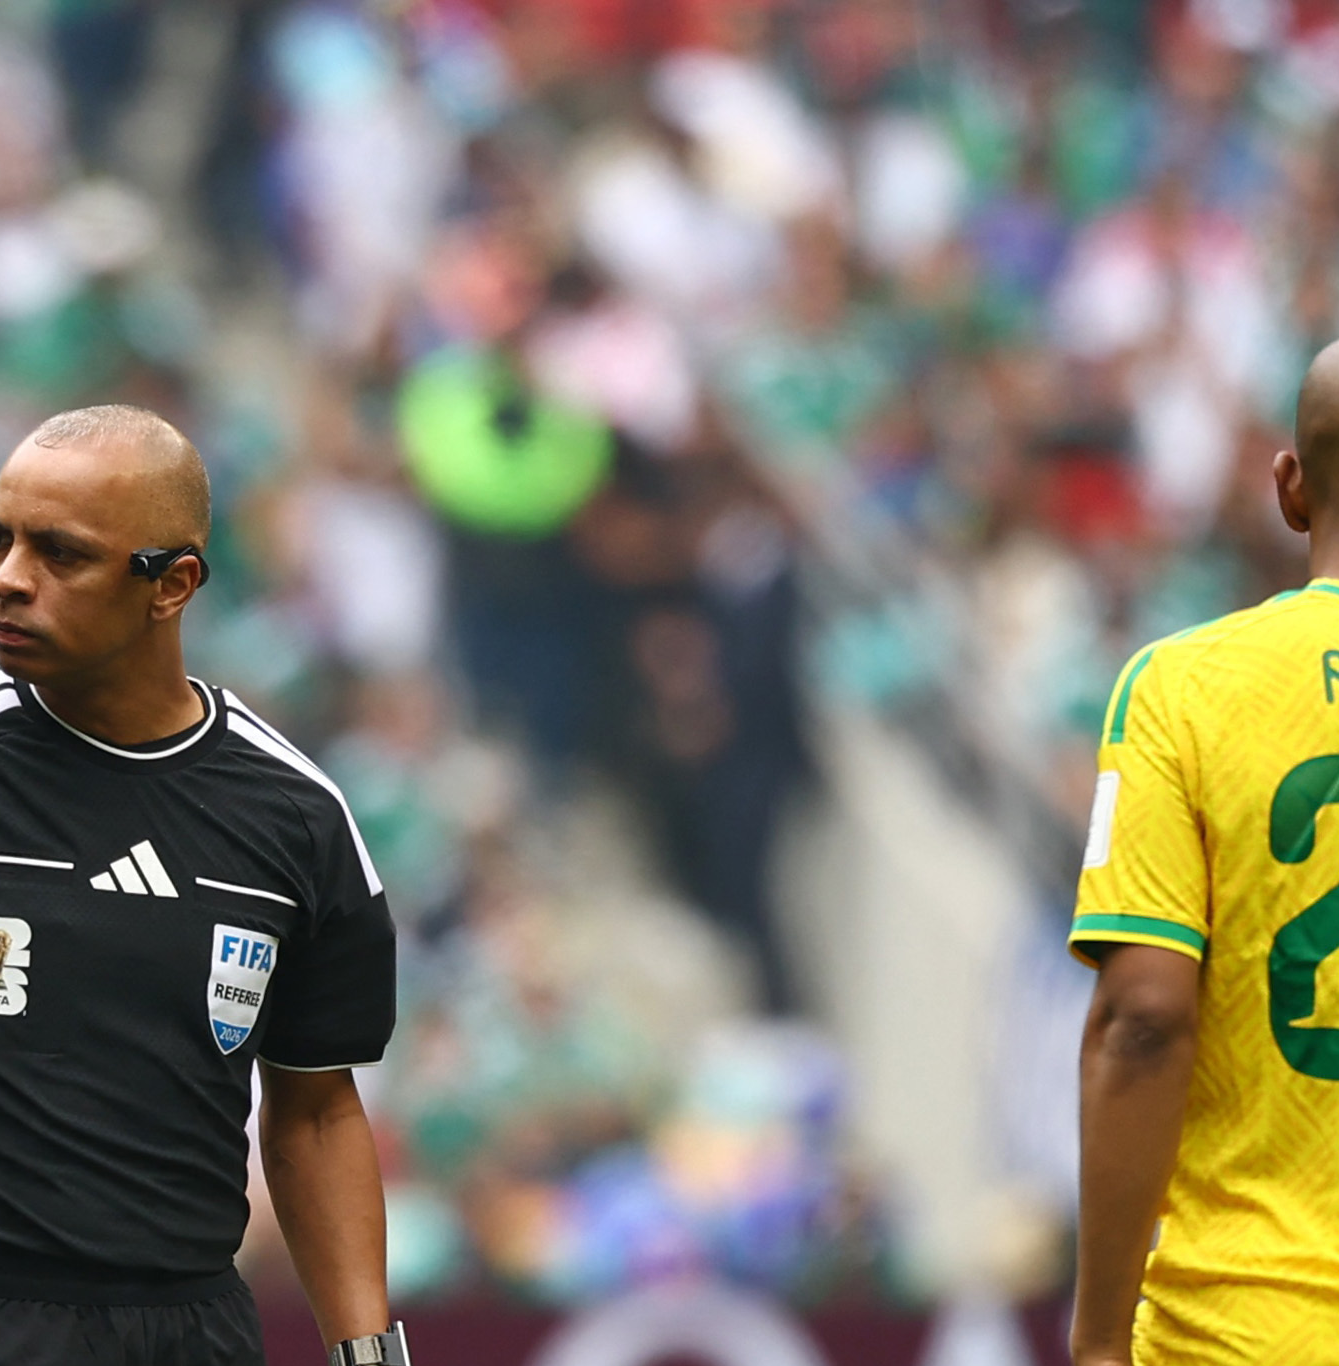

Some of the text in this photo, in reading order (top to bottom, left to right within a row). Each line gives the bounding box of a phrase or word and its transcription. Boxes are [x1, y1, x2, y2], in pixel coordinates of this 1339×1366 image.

[220, 934, 275, 974] FIFA
[214, 983, 262, 1007] REFEREE
[219, 1026, 242, 1043] 2026
